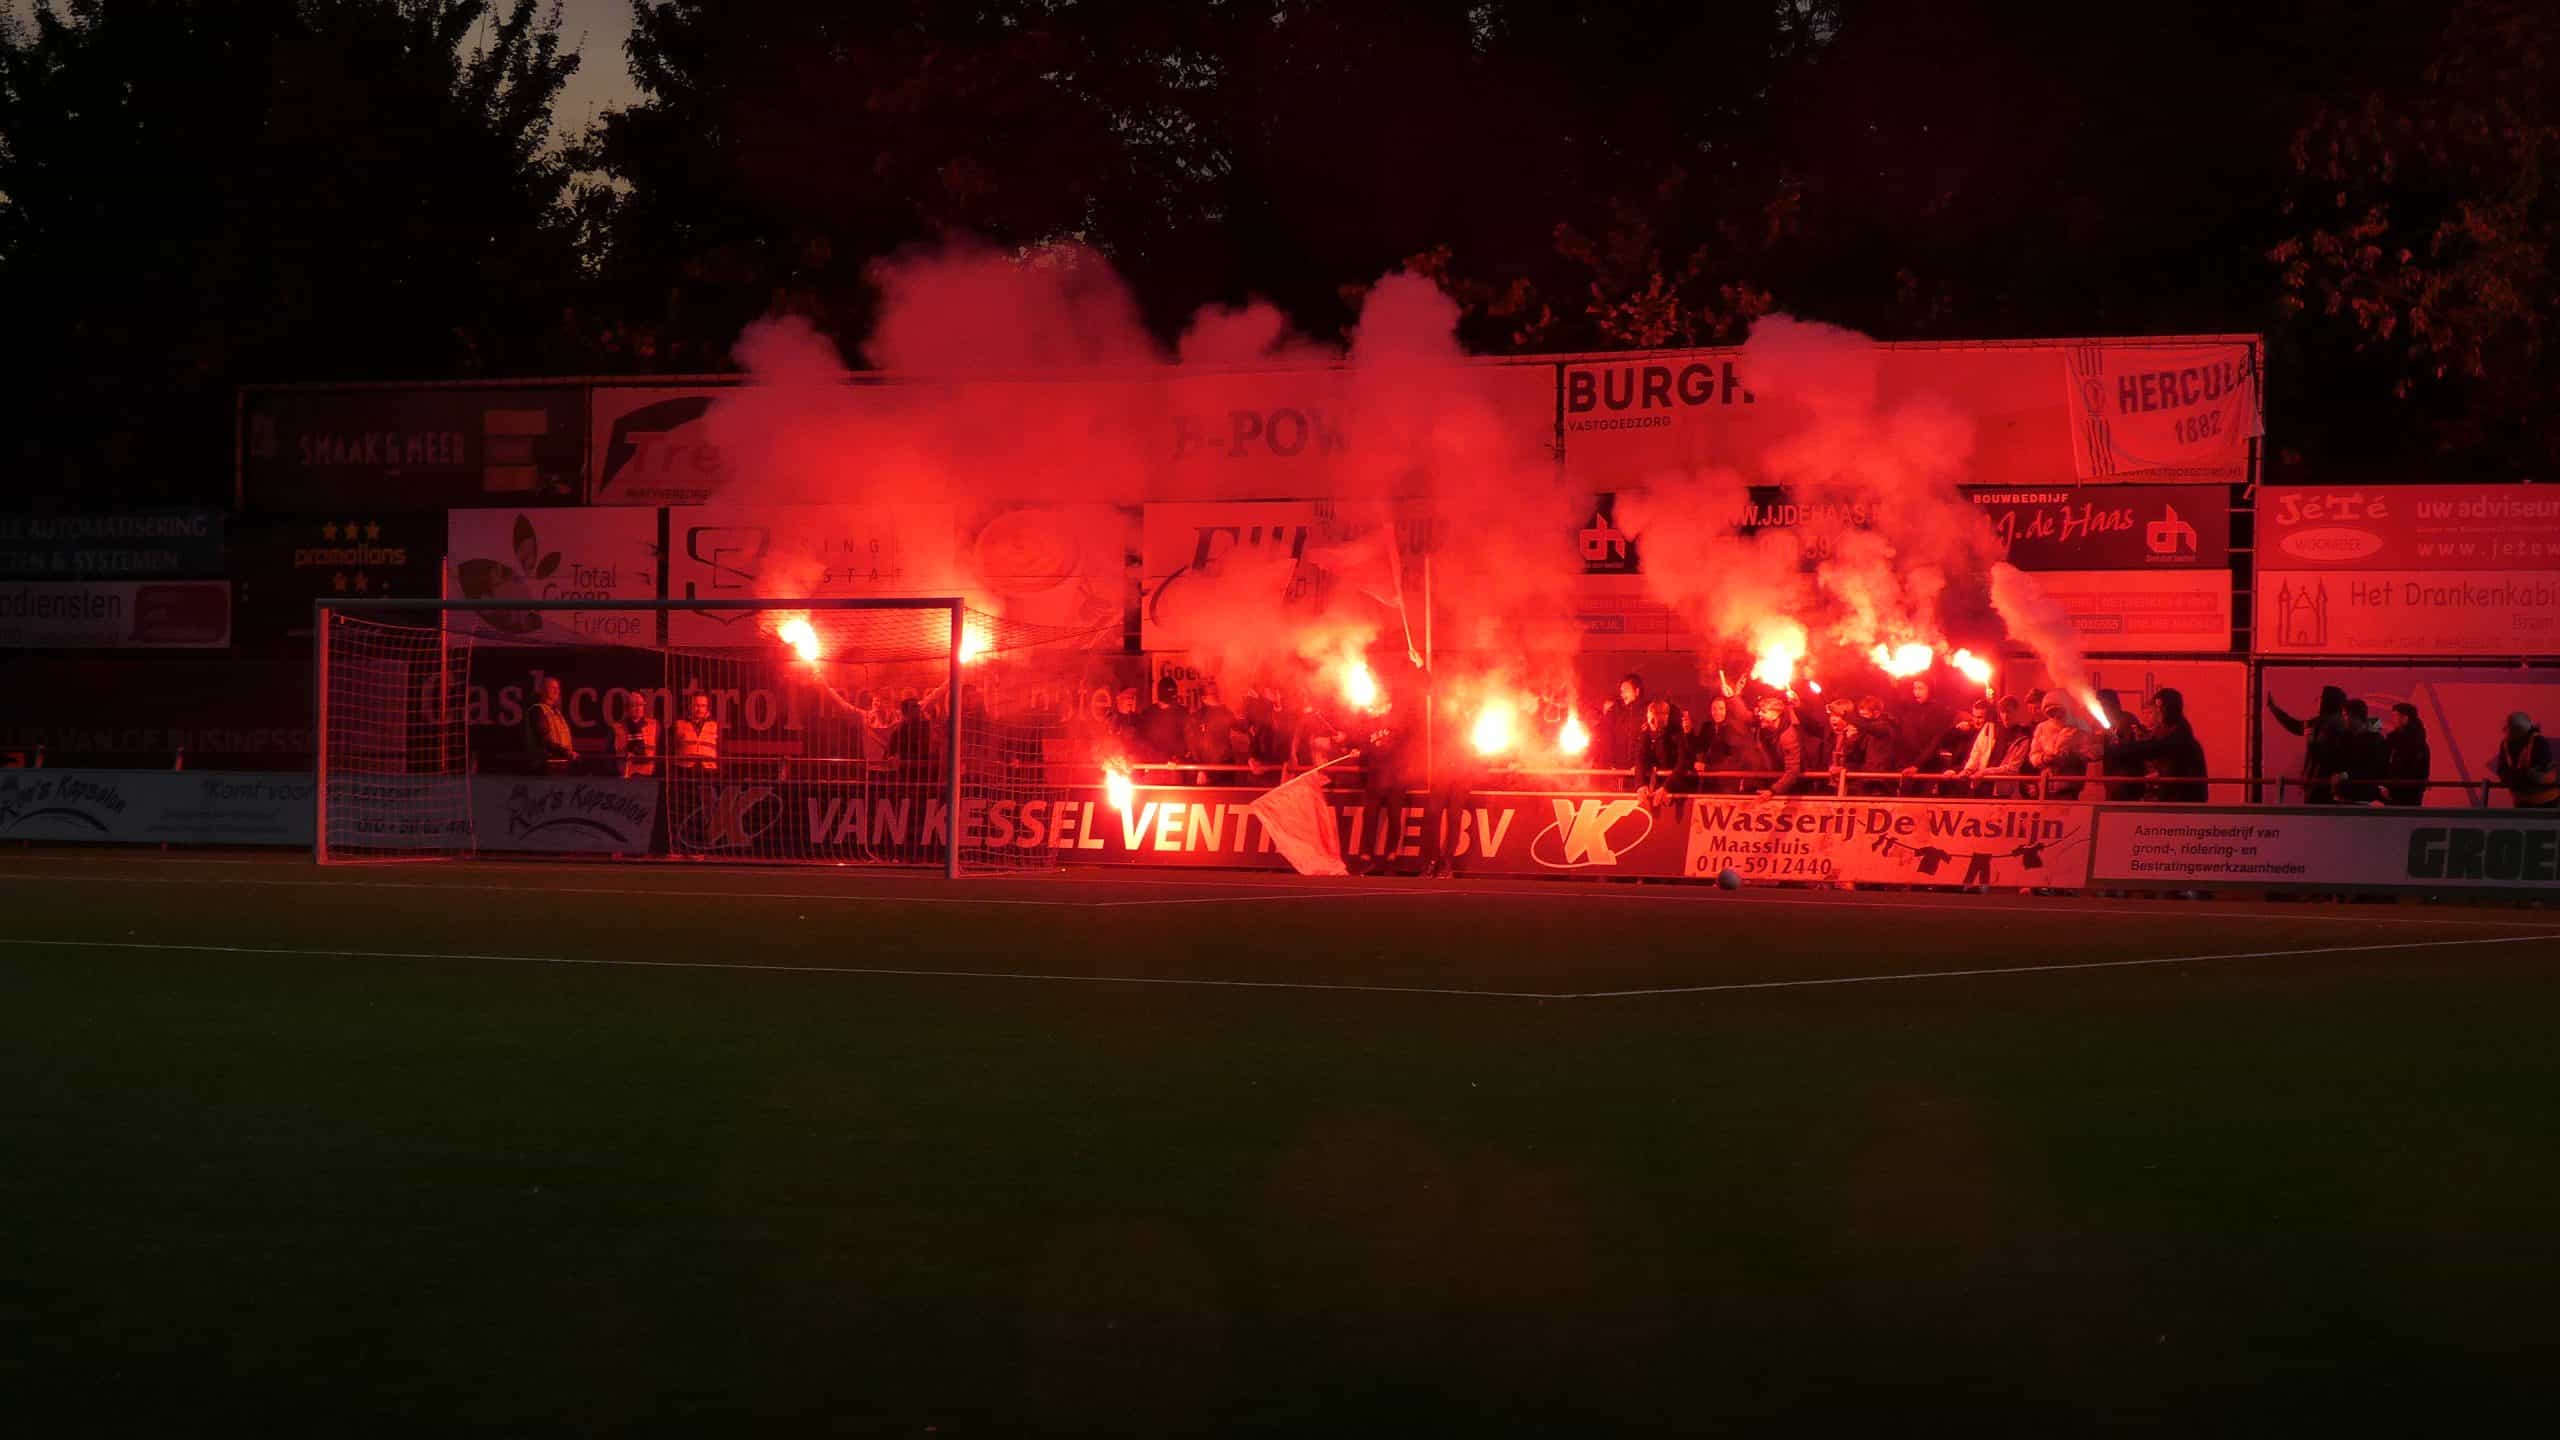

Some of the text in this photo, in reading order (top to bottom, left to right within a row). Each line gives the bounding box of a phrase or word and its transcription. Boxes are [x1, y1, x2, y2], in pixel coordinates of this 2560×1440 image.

[1973, 493, 2070, 505] BOUWBEDRIJF
[2415, 500, 2454, 519] uw
[2058, 502, 2136, 542] Haas
[568, 560, 617, 589] Total
[2350, 581, 2394, 607] Het
[573, 611, 641, 641] Europe
[807, 796, 908, 846] VAN
[920, 796, 1105, 851] KESSEL
[1700, 803, 2065, 844] Wasserij De Waslijn
[2134, 825, 2281, 841] Aannemingsbedrijf van
[1708, 835, 1810, 856] Maassluis
[2241, 845, 2258, 856] en
[1696, 855, 1832, 875] 010-5912440
[2130, 859, 2306, 875] Bestratingswerkzaamheden
